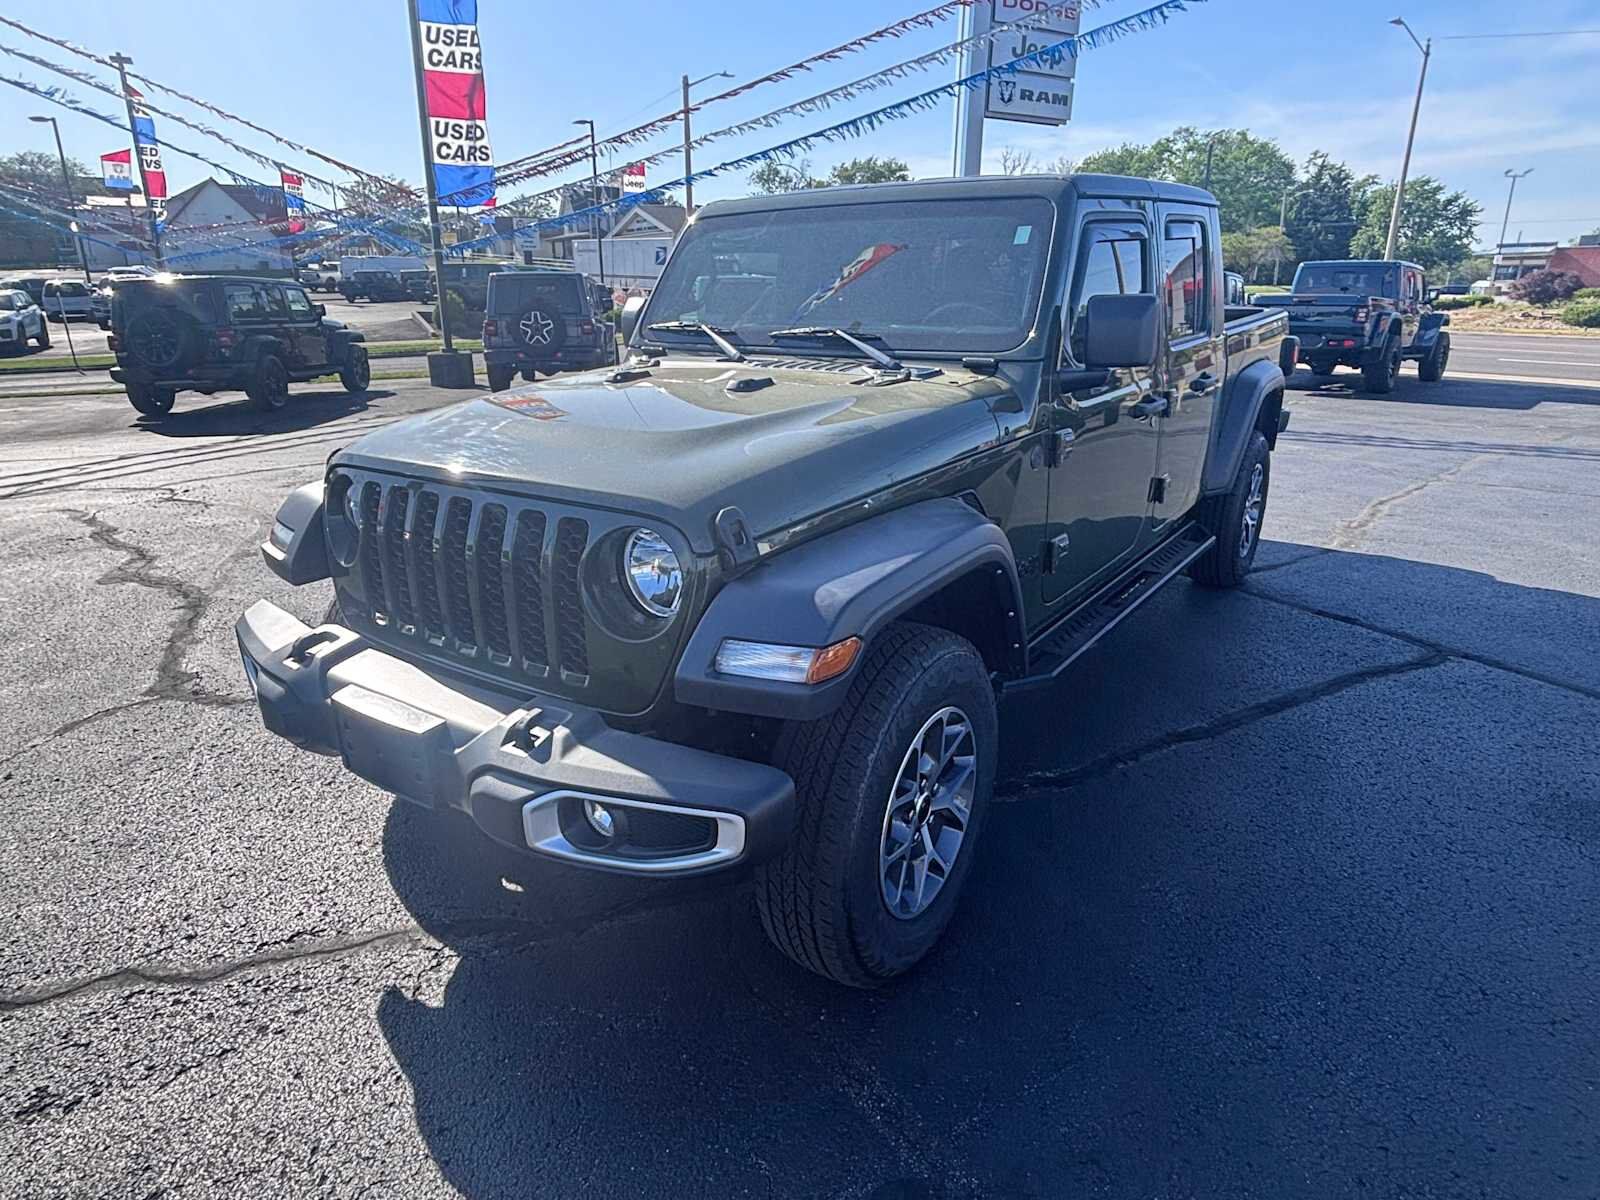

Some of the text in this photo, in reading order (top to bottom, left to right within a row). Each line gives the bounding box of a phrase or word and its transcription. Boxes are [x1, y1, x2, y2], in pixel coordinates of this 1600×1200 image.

[425, 25, 480, 47] USED
[428, 48, 481, 70] CARS
[1020, 88, 1068, 106] RAM
[434, 120, 485, 142] USED
[141, 146, 158, 157] ED
[436, 141, 490, 162] CARS
[145, 159, 161, 170] VS
[625, 179, 645, 189] Jeep
[151, 199, 166, 209] ED
